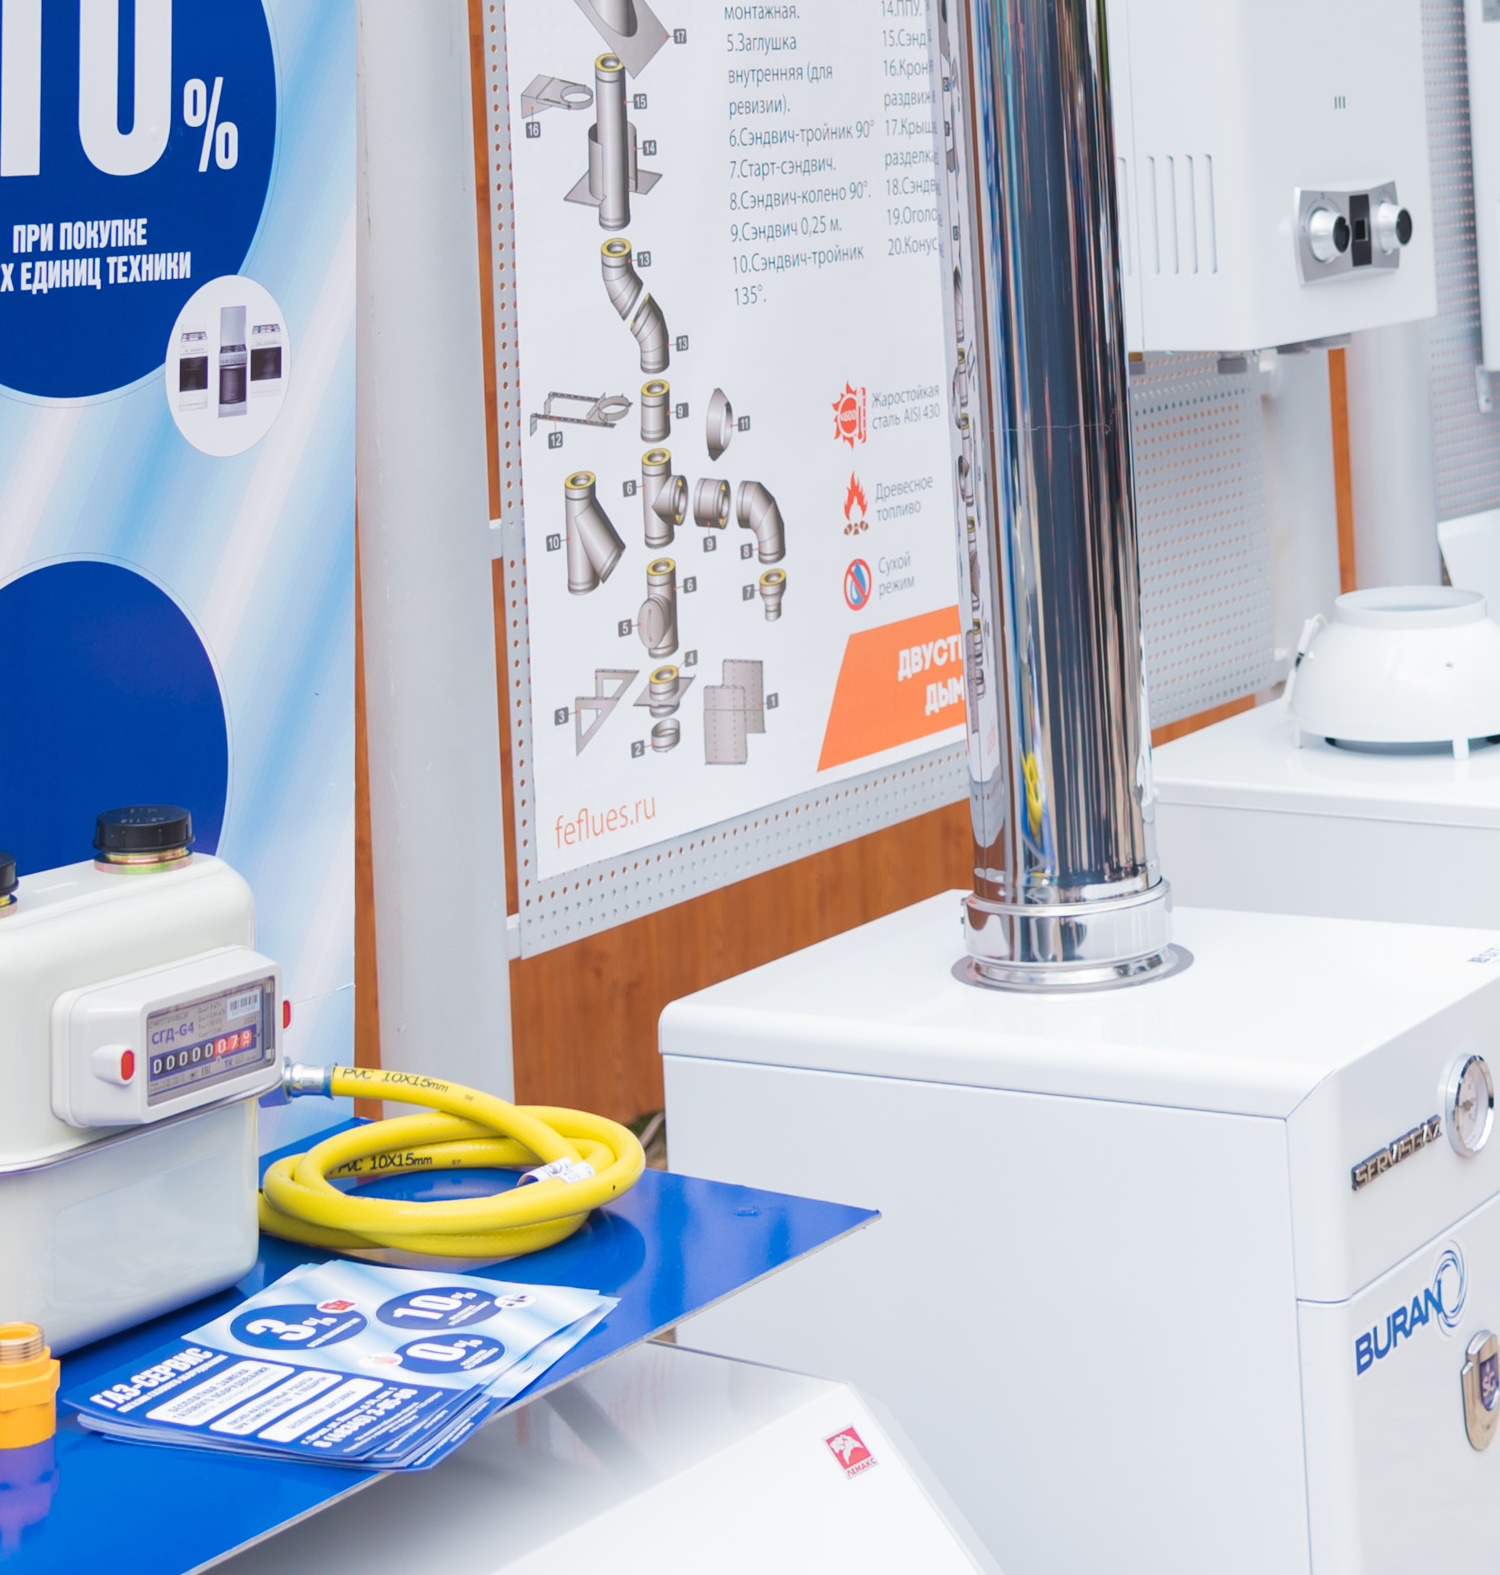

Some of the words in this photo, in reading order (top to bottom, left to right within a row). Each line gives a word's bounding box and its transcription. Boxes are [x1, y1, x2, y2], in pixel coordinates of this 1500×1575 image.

[724, 5, 800, 21] монтажная.
[881, 0, 922, 18] 14.ППУ.
[727, 32, 797, 56] 5.Заглушка
[728, 66, 803, 87] внутренняя
[807, 61, 833, 83] (для
[729, 94, 791, 120] ревизии).
[729, 123, 853, 148] 6.Сэндвич-тройник
[730, 157, 836, 181] 7.Старт-сэндвич.
[729, 185, 846, 212] 8.Сэндвич-колено
[12, 221, 54, 254] ПРИ
[60, 217, 149, 252] ПОКУПКЕ
[730, 221, 798, 243] 9.Сэндвич
[801, 215, 827, 238] 0,25
[20, 256, 102, 293] ЕДИНИЦ
[106, 251, 192, 285] ТЕХНИКИ
[733, 244, 864, 274] 10.Сэндвич-тройник
[871, 385, 940, 410] Жаростойкая
[871, 414, 901, 430] сталь
[904, 406, 922, 424] AISI
[923, 403, 941, 419] 430
[875, 475, 933, 504] Древесное
[876, 499, 921, 522] топливо
[878, 551, 911, 577] Сухой
[878, 574, 915, 600] режим
[554, 795, 657, 849] feflues.ru
[342, 1067, 375, 1080] PVC
[1352, 1116, 1443, 1190] SERVISGAZ
[1355, 1278, 1444, 1376] BURAN
[90, 1347, 213, 1409] ГАЗ-СЕРВИС
